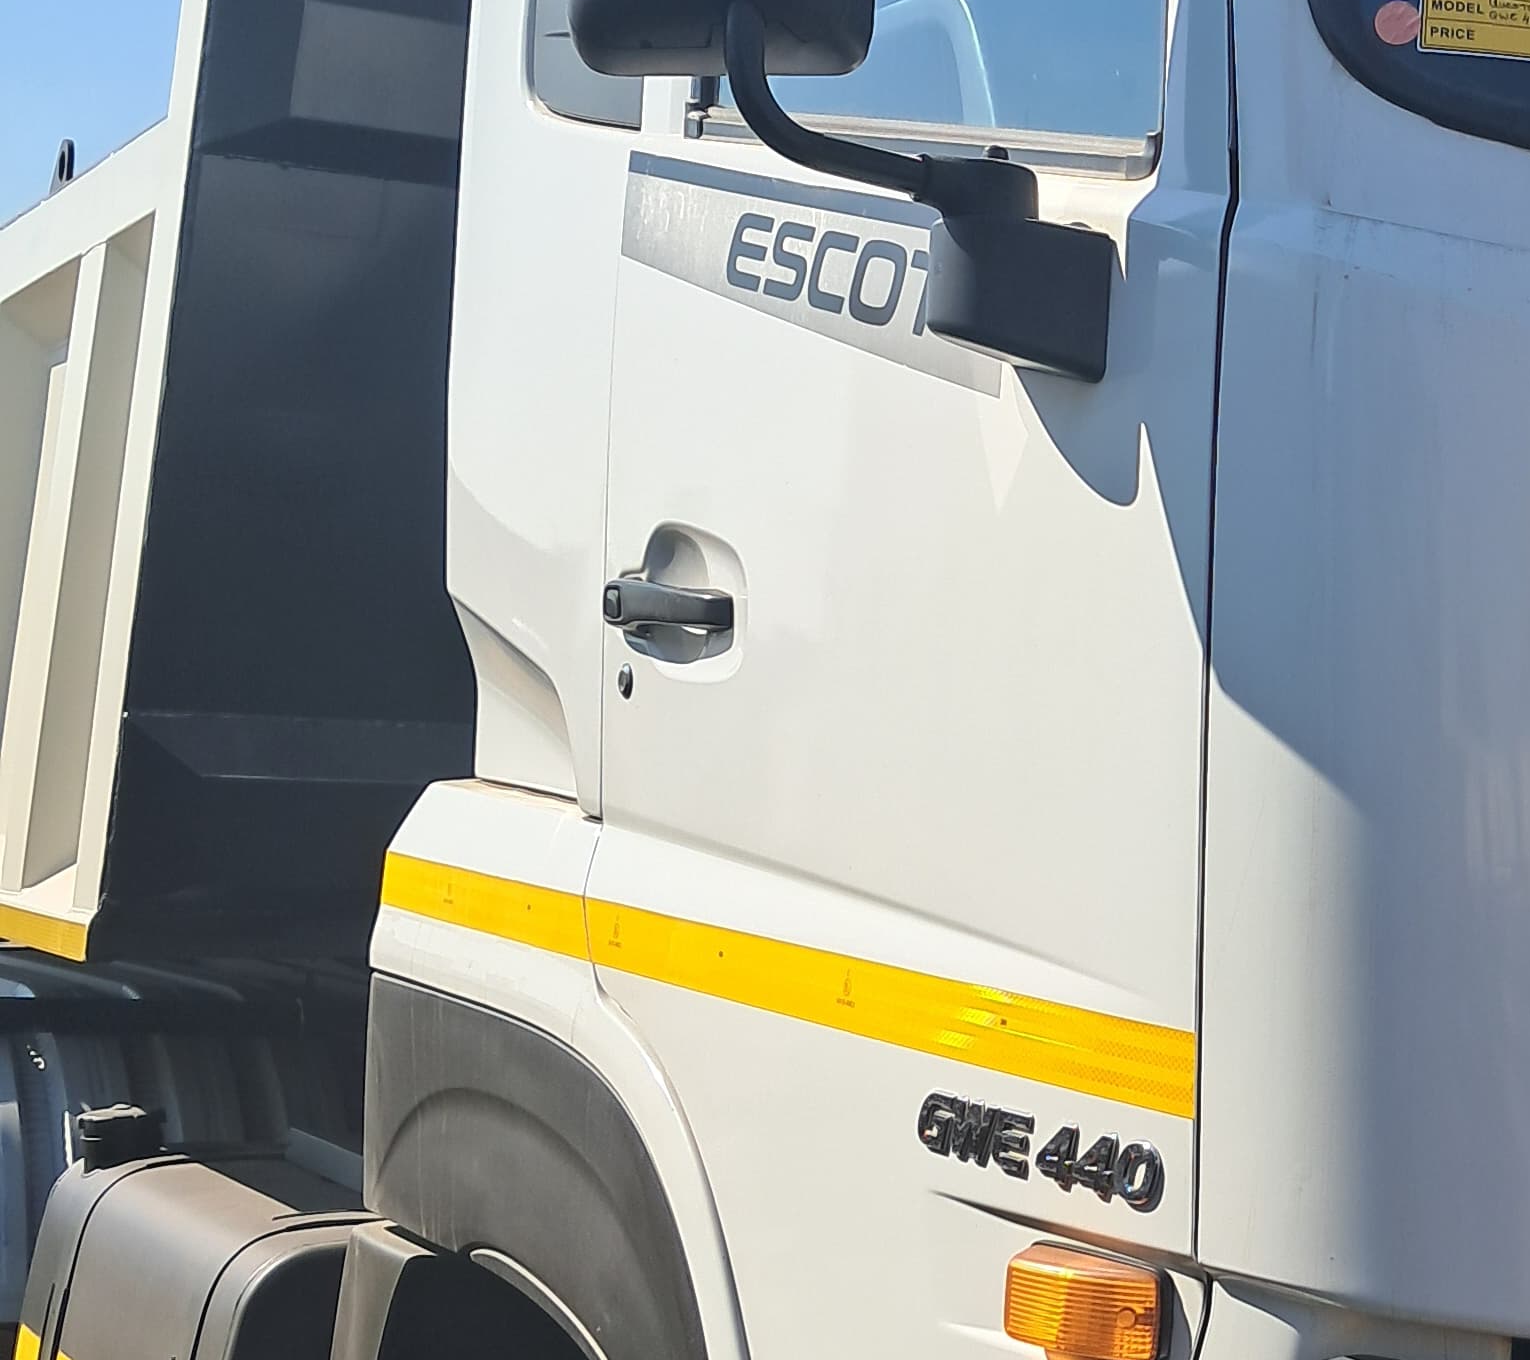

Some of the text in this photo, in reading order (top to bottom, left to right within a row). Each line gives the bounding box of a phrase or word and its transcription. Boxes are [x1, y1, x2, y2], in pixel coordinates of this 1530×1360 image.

[1431, 0, 1485, 15] MODEL
[1430, 26, 1476, 41] PRICE
[917, 1088, 1166, 1213] GWE 440
